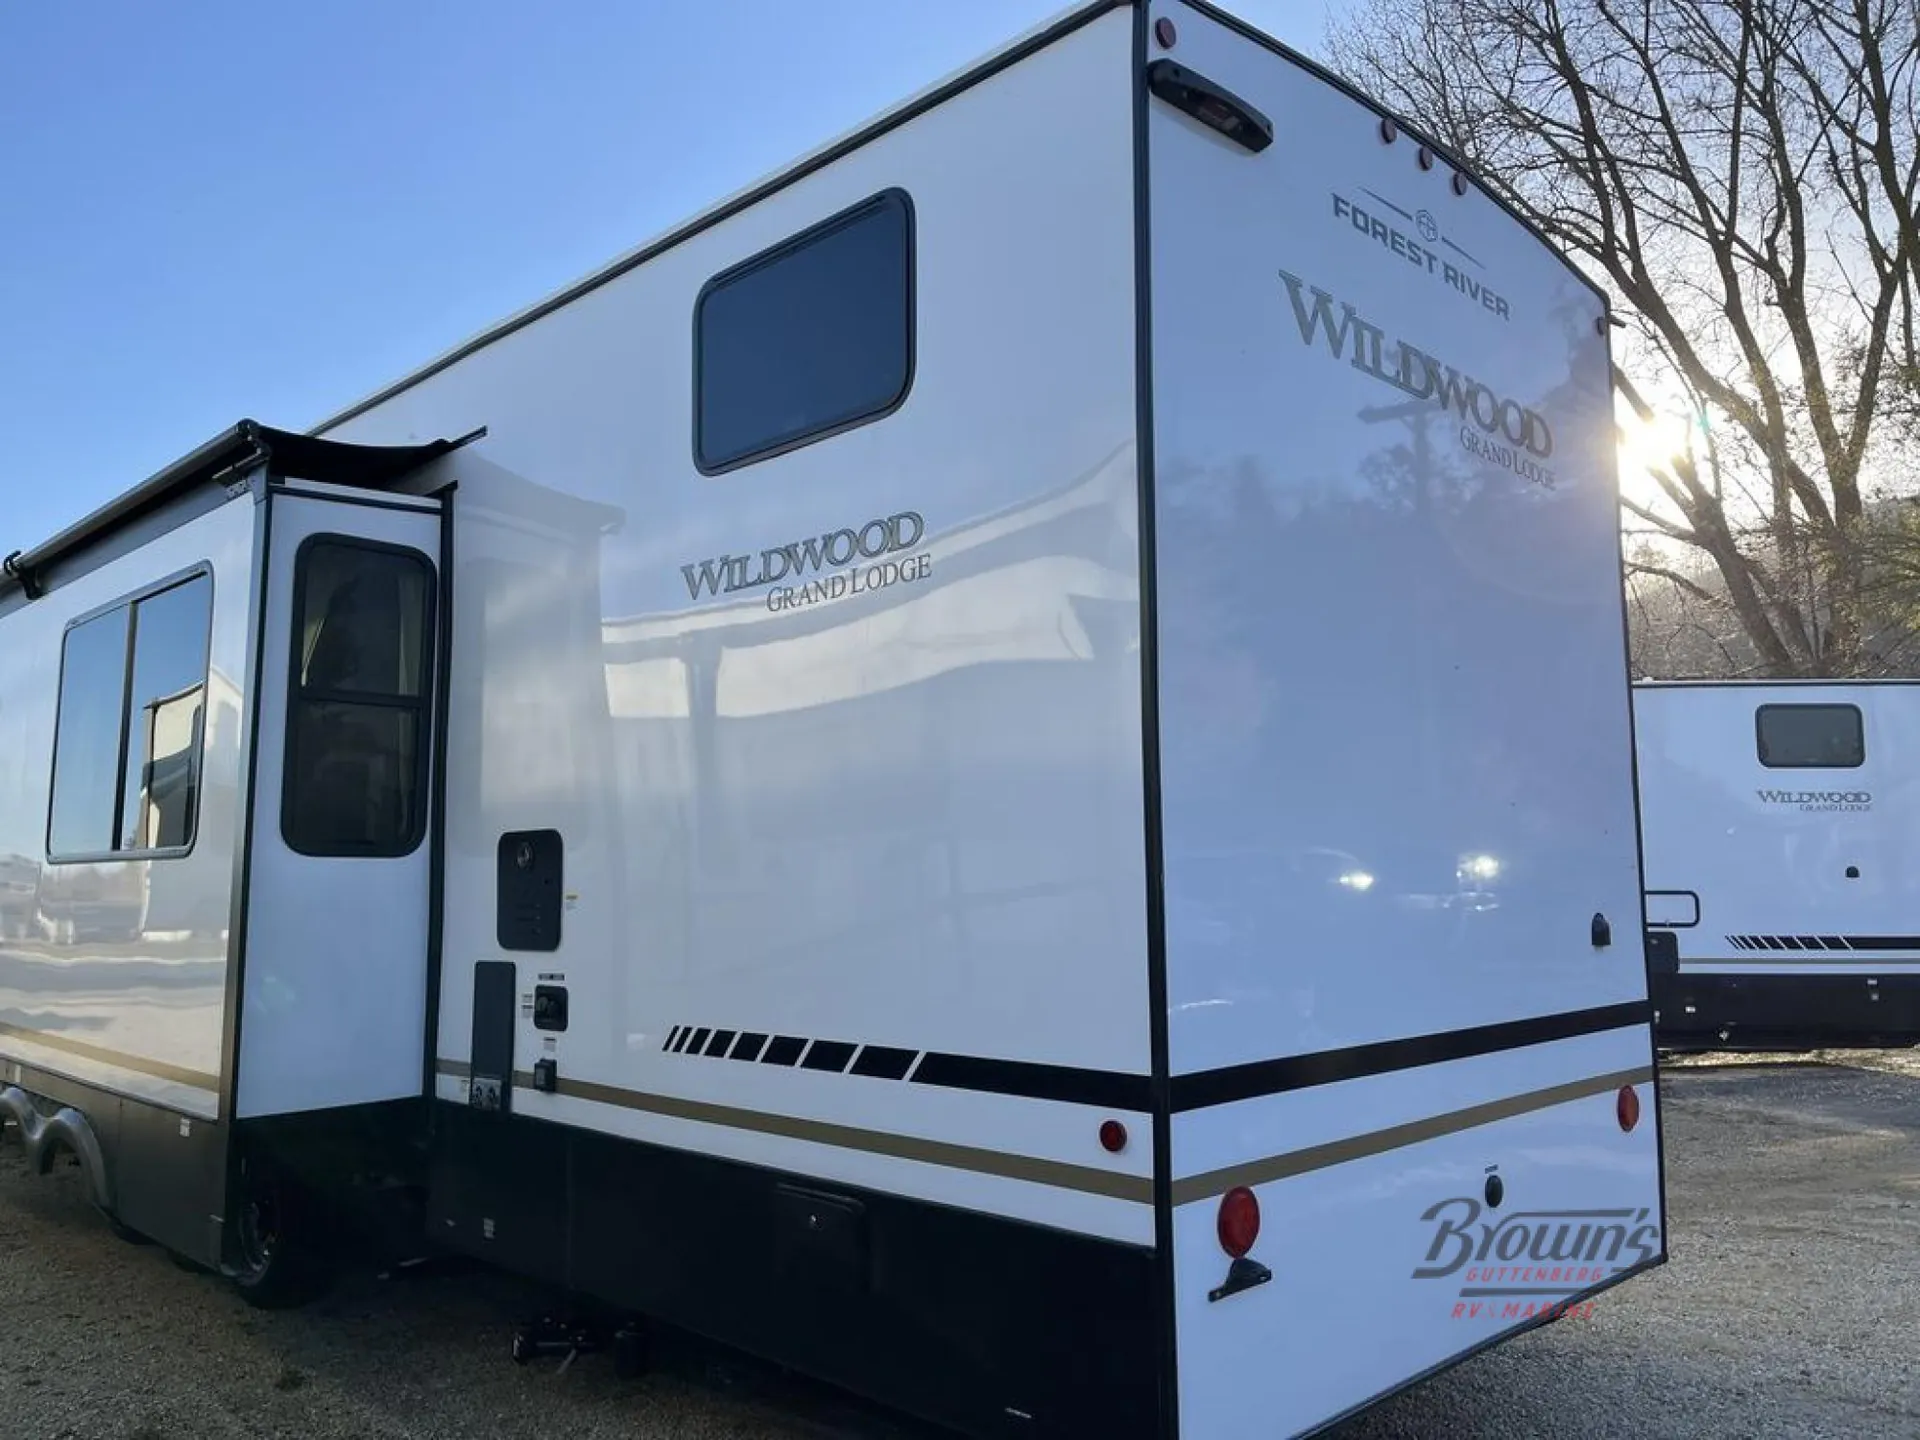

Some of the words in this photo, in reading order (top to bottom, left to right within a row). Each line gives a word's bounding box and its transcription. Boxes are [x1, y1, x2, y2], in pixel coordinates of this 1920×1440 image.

[1331, 193, 1437, 274] FOREST
[1443, 261, 1510, 321] RIVER
[1278, 269, 1553, 458] WILDWOOD
[1460, 426, 1513, 475] GRAND
[1513, 450, 1556, 490] LODGE
[681, 511, 924, 600] WILDWOOD
[766, 575, 847, 612] GRAND
[851, 553, 933, 594] LODGE
[1756, 790, 1872, 803] WILDWOOD
